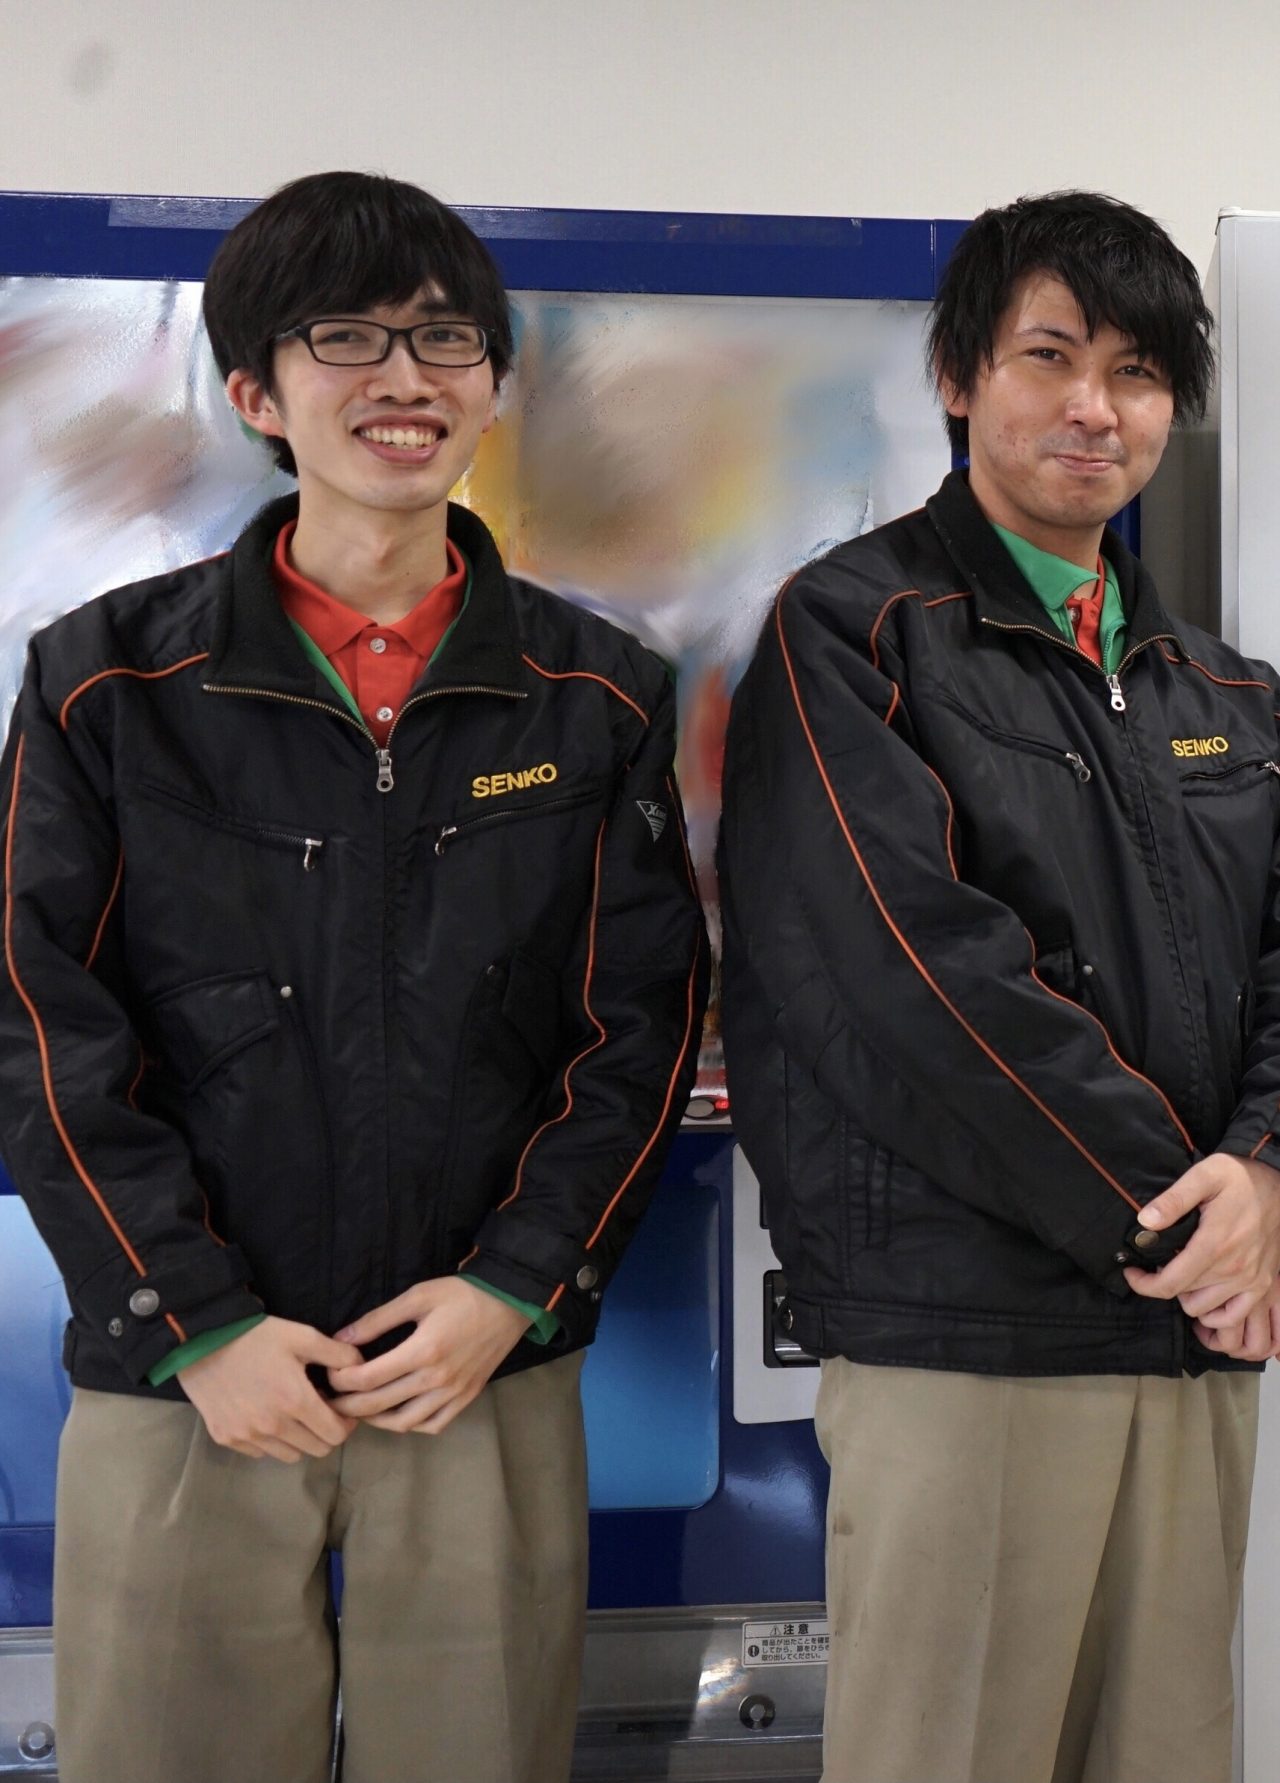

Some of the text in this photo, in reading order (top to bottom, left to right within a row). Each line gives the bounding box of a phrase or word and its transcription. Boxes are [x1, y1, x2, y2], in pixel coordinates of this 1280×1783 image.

[1171, 736, 1229, 757] SENKO
[471, 763, 558, 798] SENKO
[783, 1623, 809, 1635] 注意
